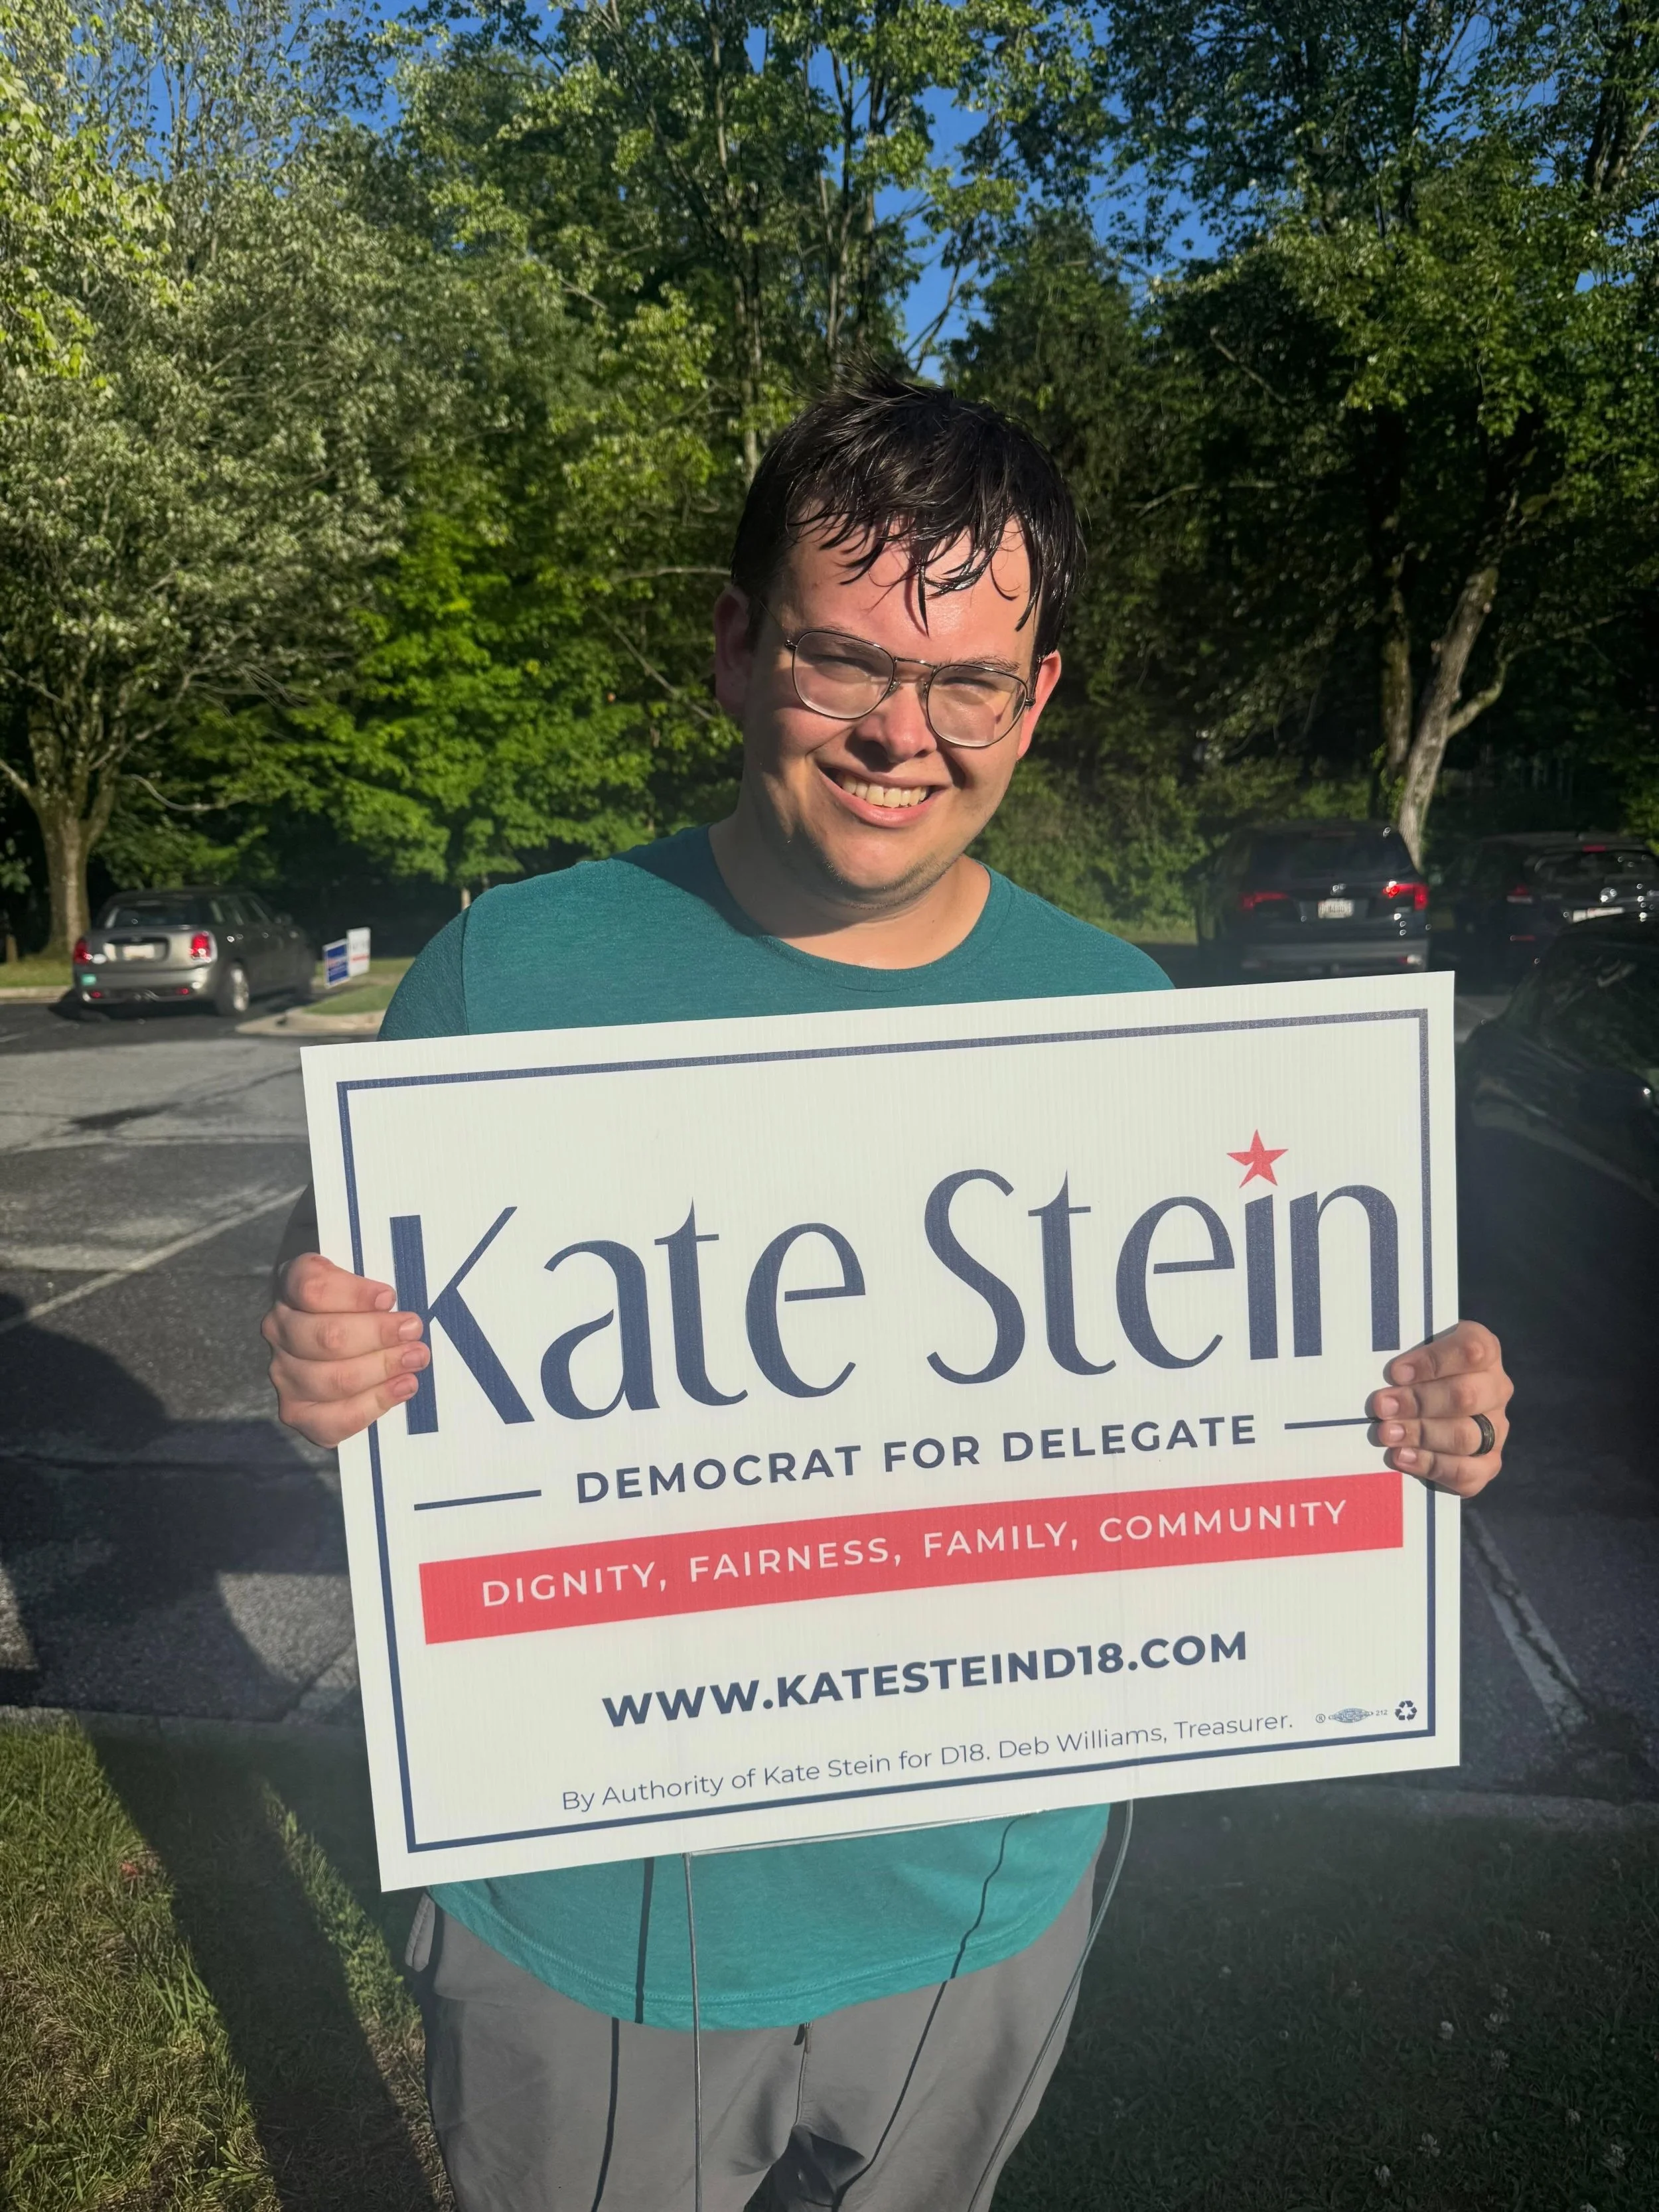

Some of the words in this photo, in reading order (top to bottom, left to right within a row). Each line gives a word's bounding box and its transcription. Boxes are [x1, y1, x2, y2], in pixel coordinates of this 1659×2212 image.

[390, 1197, 865, 1435] Kate
[924, 1130, 1400, 1385] Stein
[577, 1445, 861, 1504] DEMOCRAT
[884, 1435, 981, 1473] FOR
[1003, 1414, 1256, 1462] DELEGATE
[482, 1562, 667, 1607] DIGNITY,
[690, 1538, 901, 1583] FAIRNESS,
[924, 1521, 1078, 1558] FAMILY,
[1100, 1499, 1347, 1542] COMMUNITY
[601, 1631, 1247, 1728] WWW.KATESTEIND18.COM
[563, 1791, 595, 1812] By
[602, 1773, 724, 1806] Authority
[731, 1768, 757, 1789] of
[764, 1765, 820, 1786] Kate
[828, 1756, 891, 1778] Stein
[899, 1749, 933, 1770] for
[941, 1743, 991, 1765] D18.
[999, 1736, 1050, 1759] Deb
[1056, 1727, 1167, 1753] Williams,
[1174, 1712, 1293, 1739] Treasurer.
